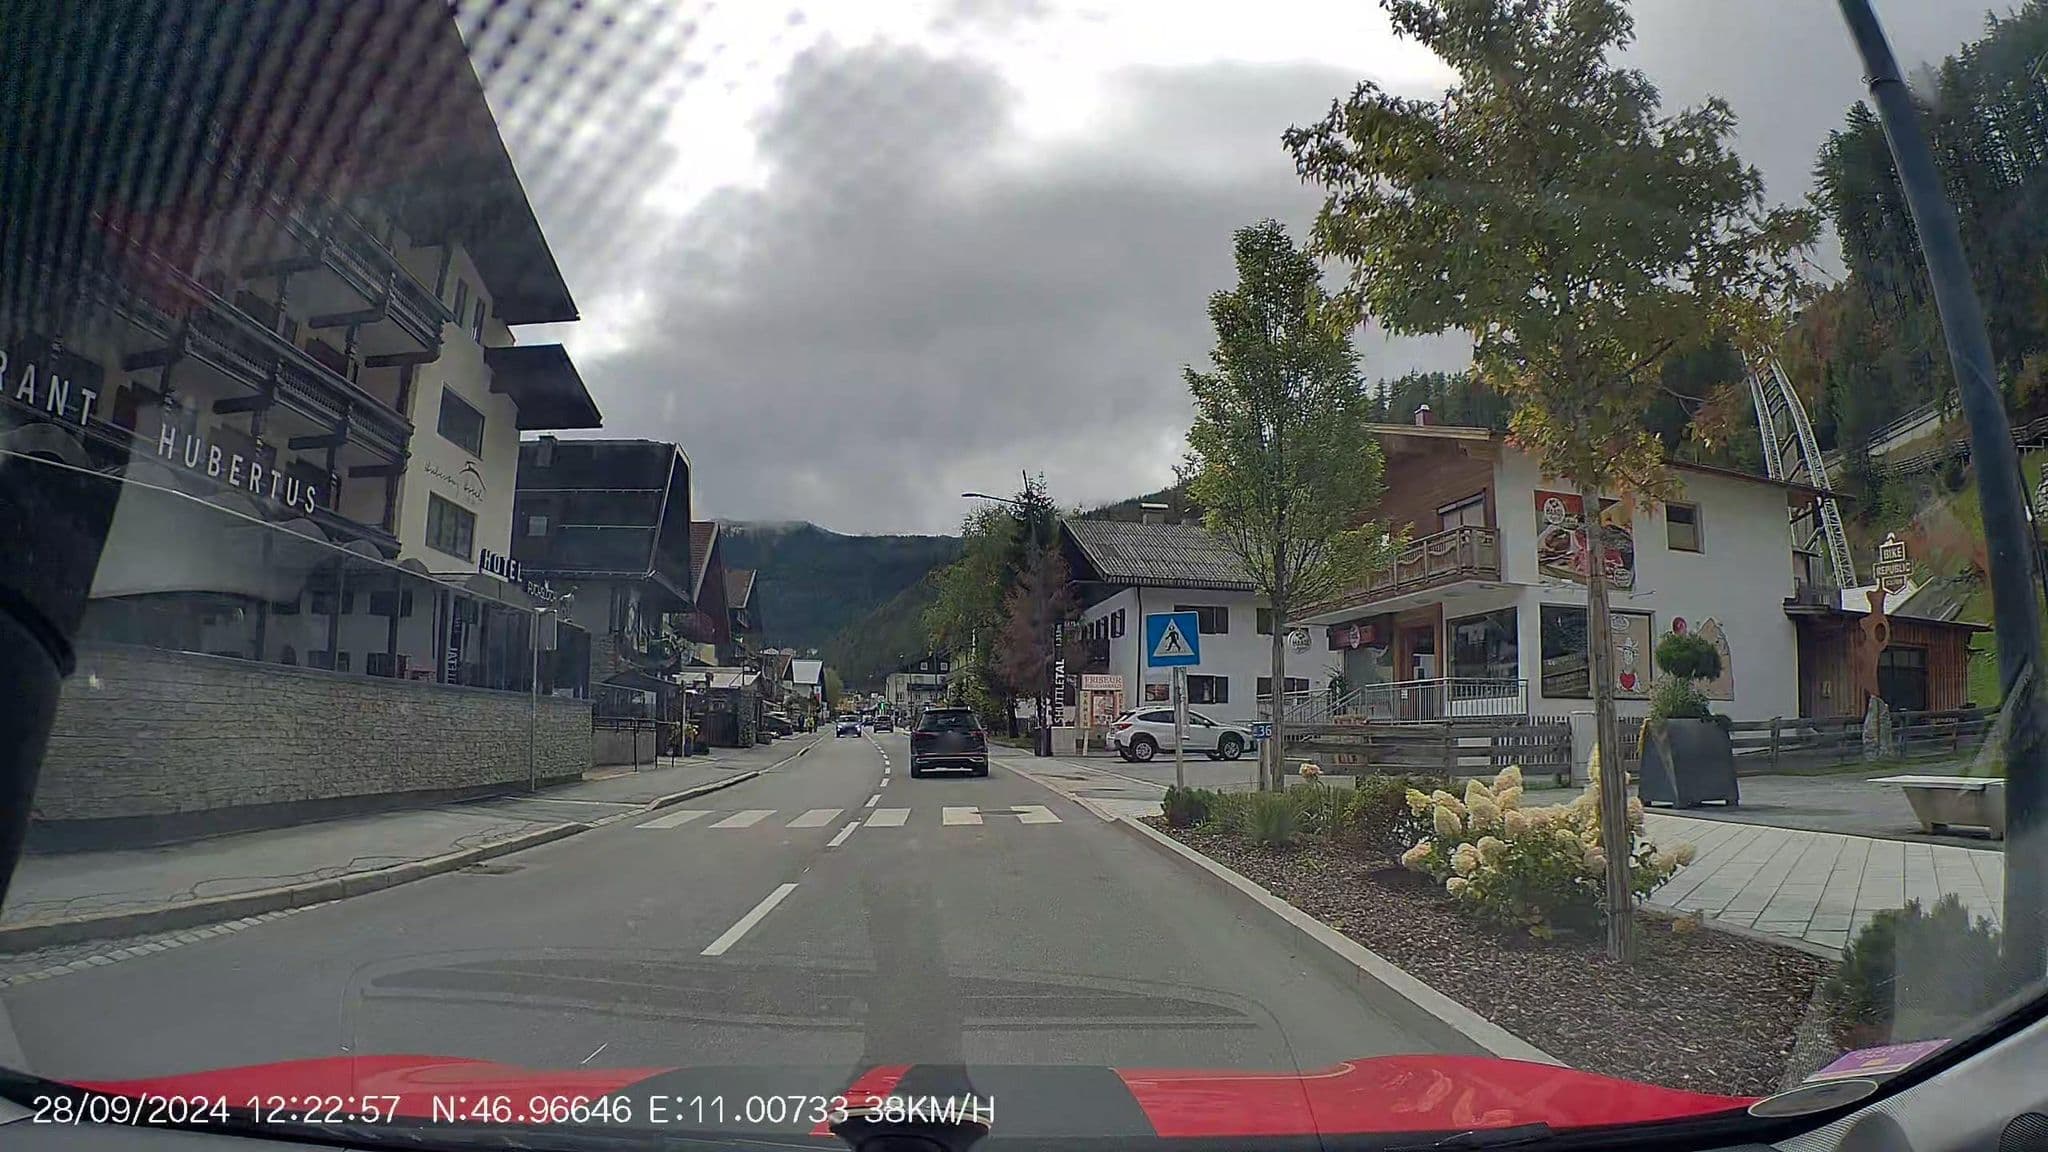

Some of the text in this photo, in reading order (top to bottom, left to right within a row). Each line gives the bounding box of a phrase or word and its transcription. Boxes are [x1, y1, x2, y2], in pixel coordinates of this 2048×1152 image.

[158, 424, 316, 513] HUBERTUS
[484, 548, 522, 582] HOTEL
[1876, 562, 1911, 576] REPUBLIC
[1883, 546, 1903, 560] BIKE
[1055, 658, 1065, 724] SHUTTLETAL
